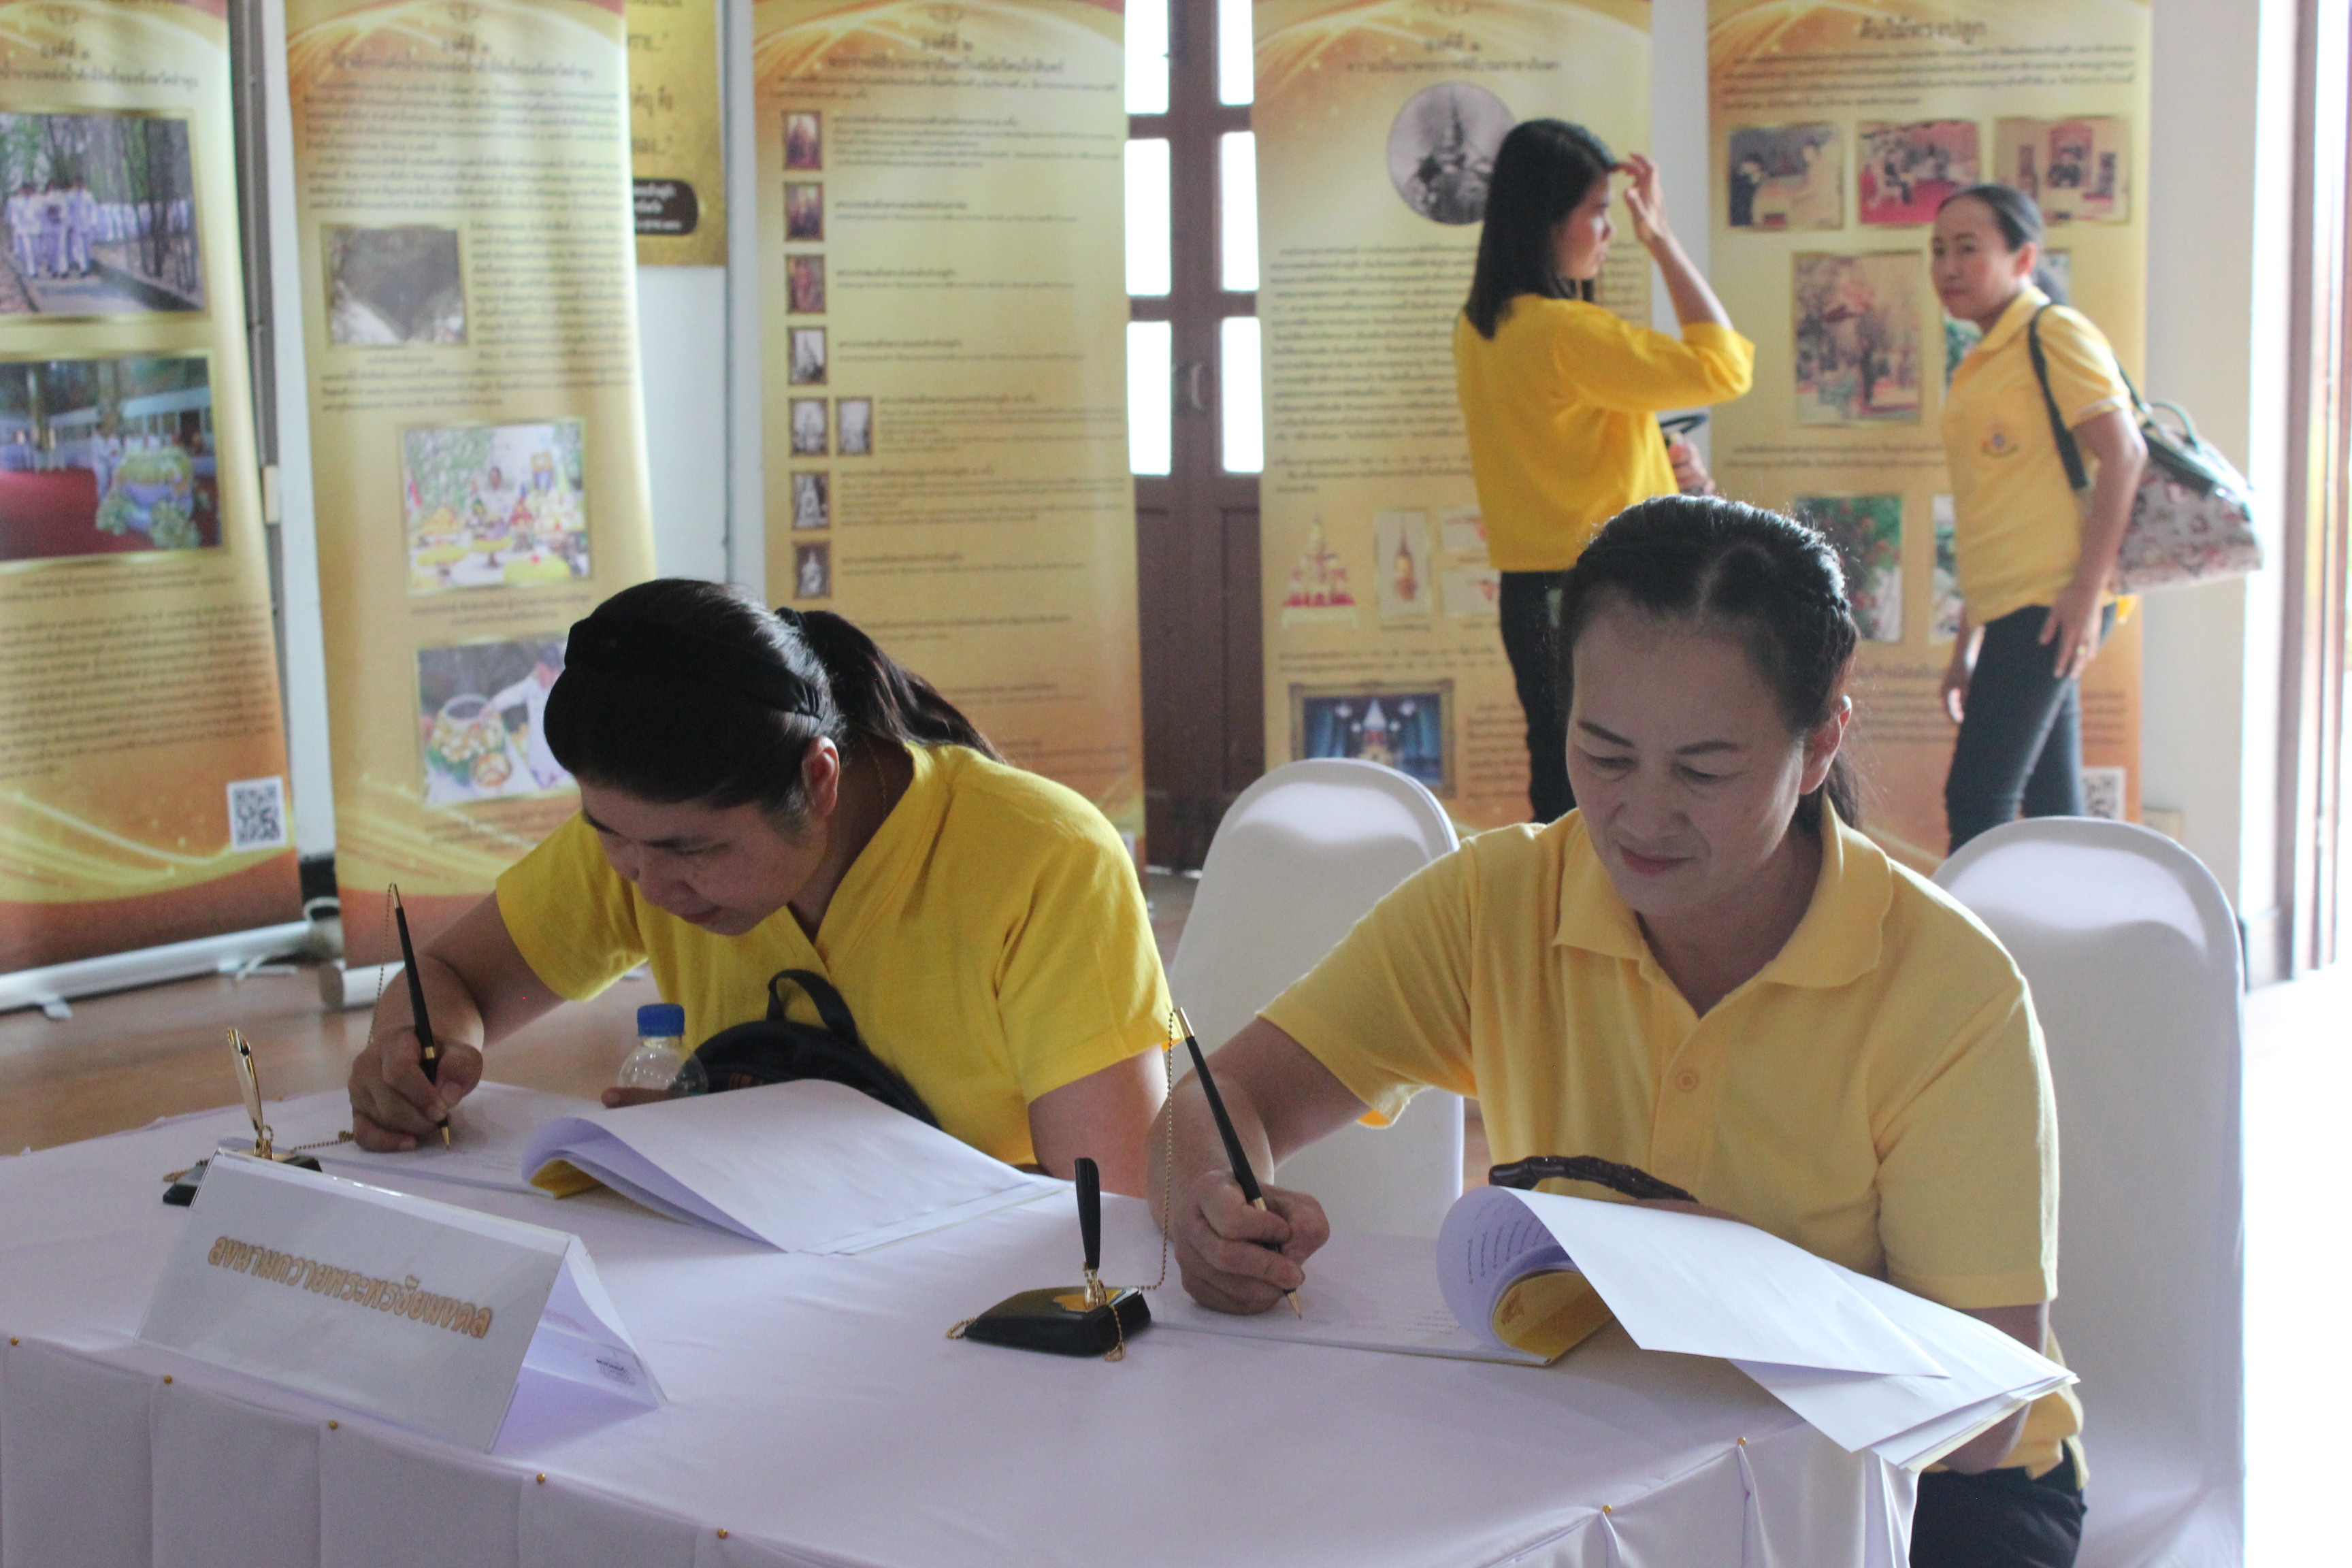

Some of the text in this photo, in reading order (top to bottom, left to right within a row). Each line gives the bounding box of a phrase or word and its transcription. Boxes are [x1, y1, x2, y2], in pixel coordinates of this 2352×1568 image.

[208, 1235, 493, 1339] ลงนามถวายพระพรชัยมงคล
